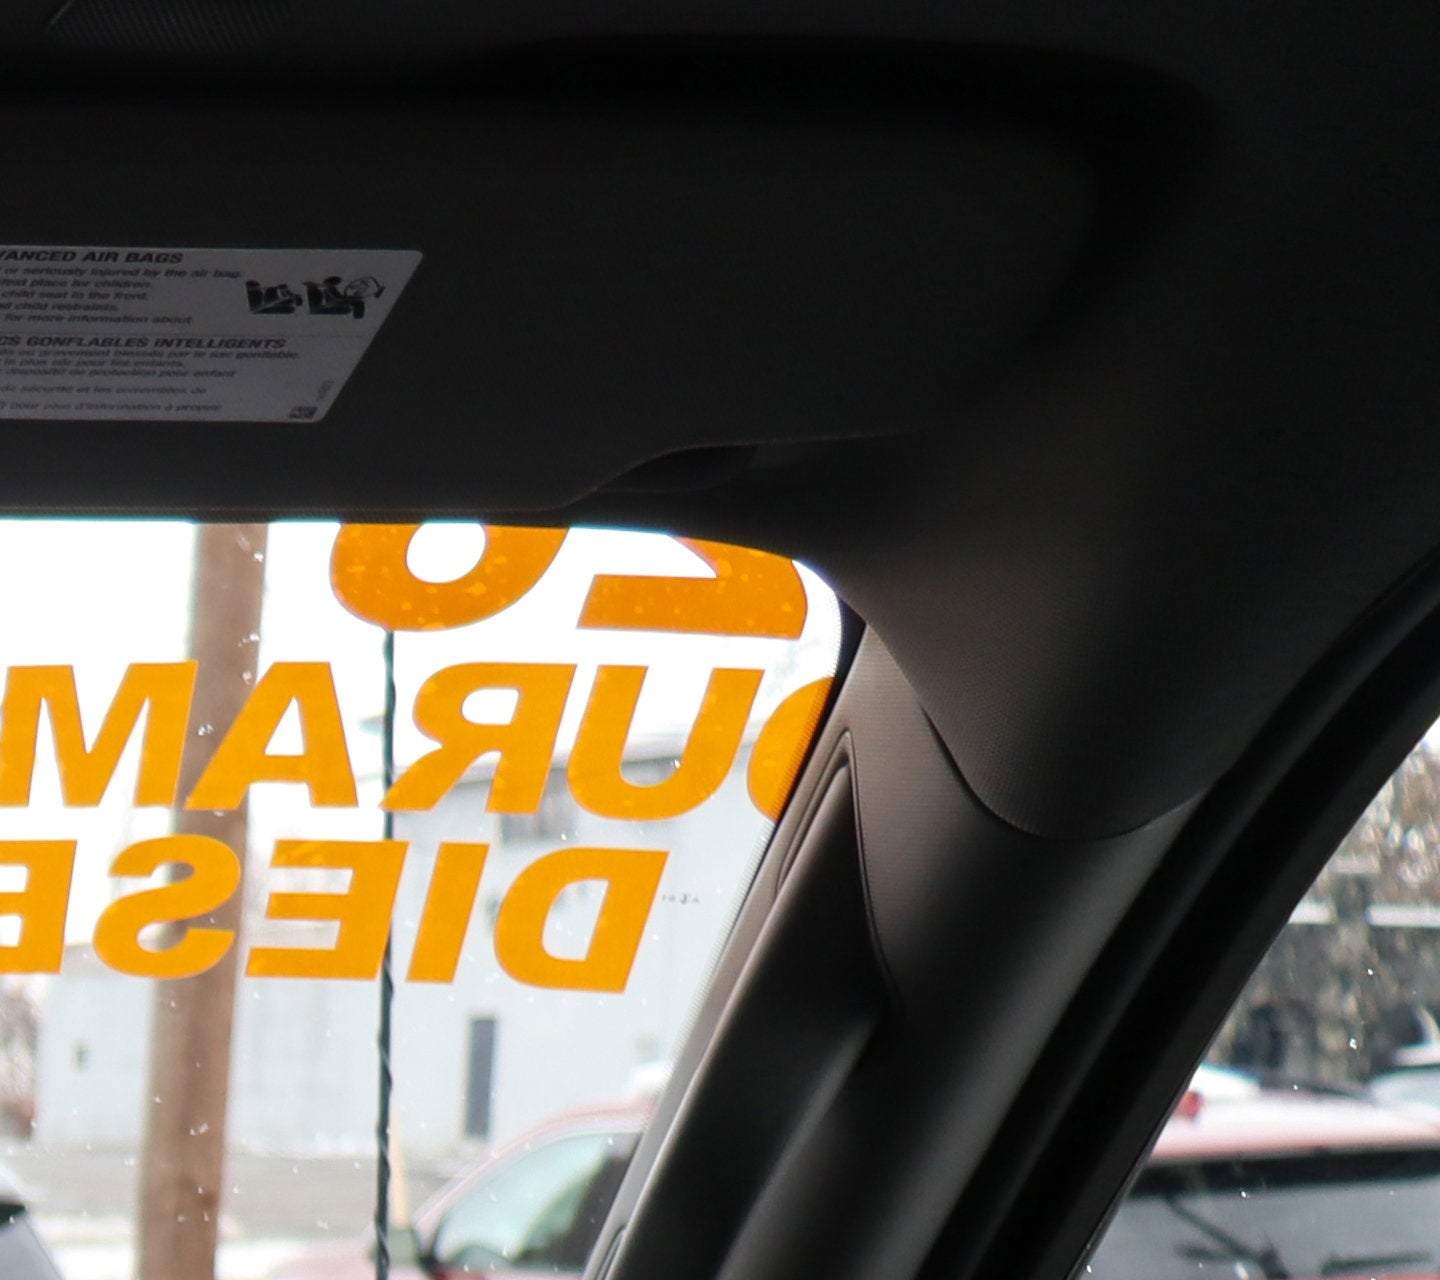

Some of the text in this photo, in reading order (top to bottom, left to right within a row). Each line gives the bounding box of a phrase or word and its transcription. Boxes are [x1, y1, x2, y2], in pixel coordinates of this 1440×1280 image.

[81, 251, 119, 262] AIR
[124, 252, 183, 263] BAGS
[26, 335, 149, 347] GONFLABLES
[154, 337, 286, 349] INTELLIGENTS
